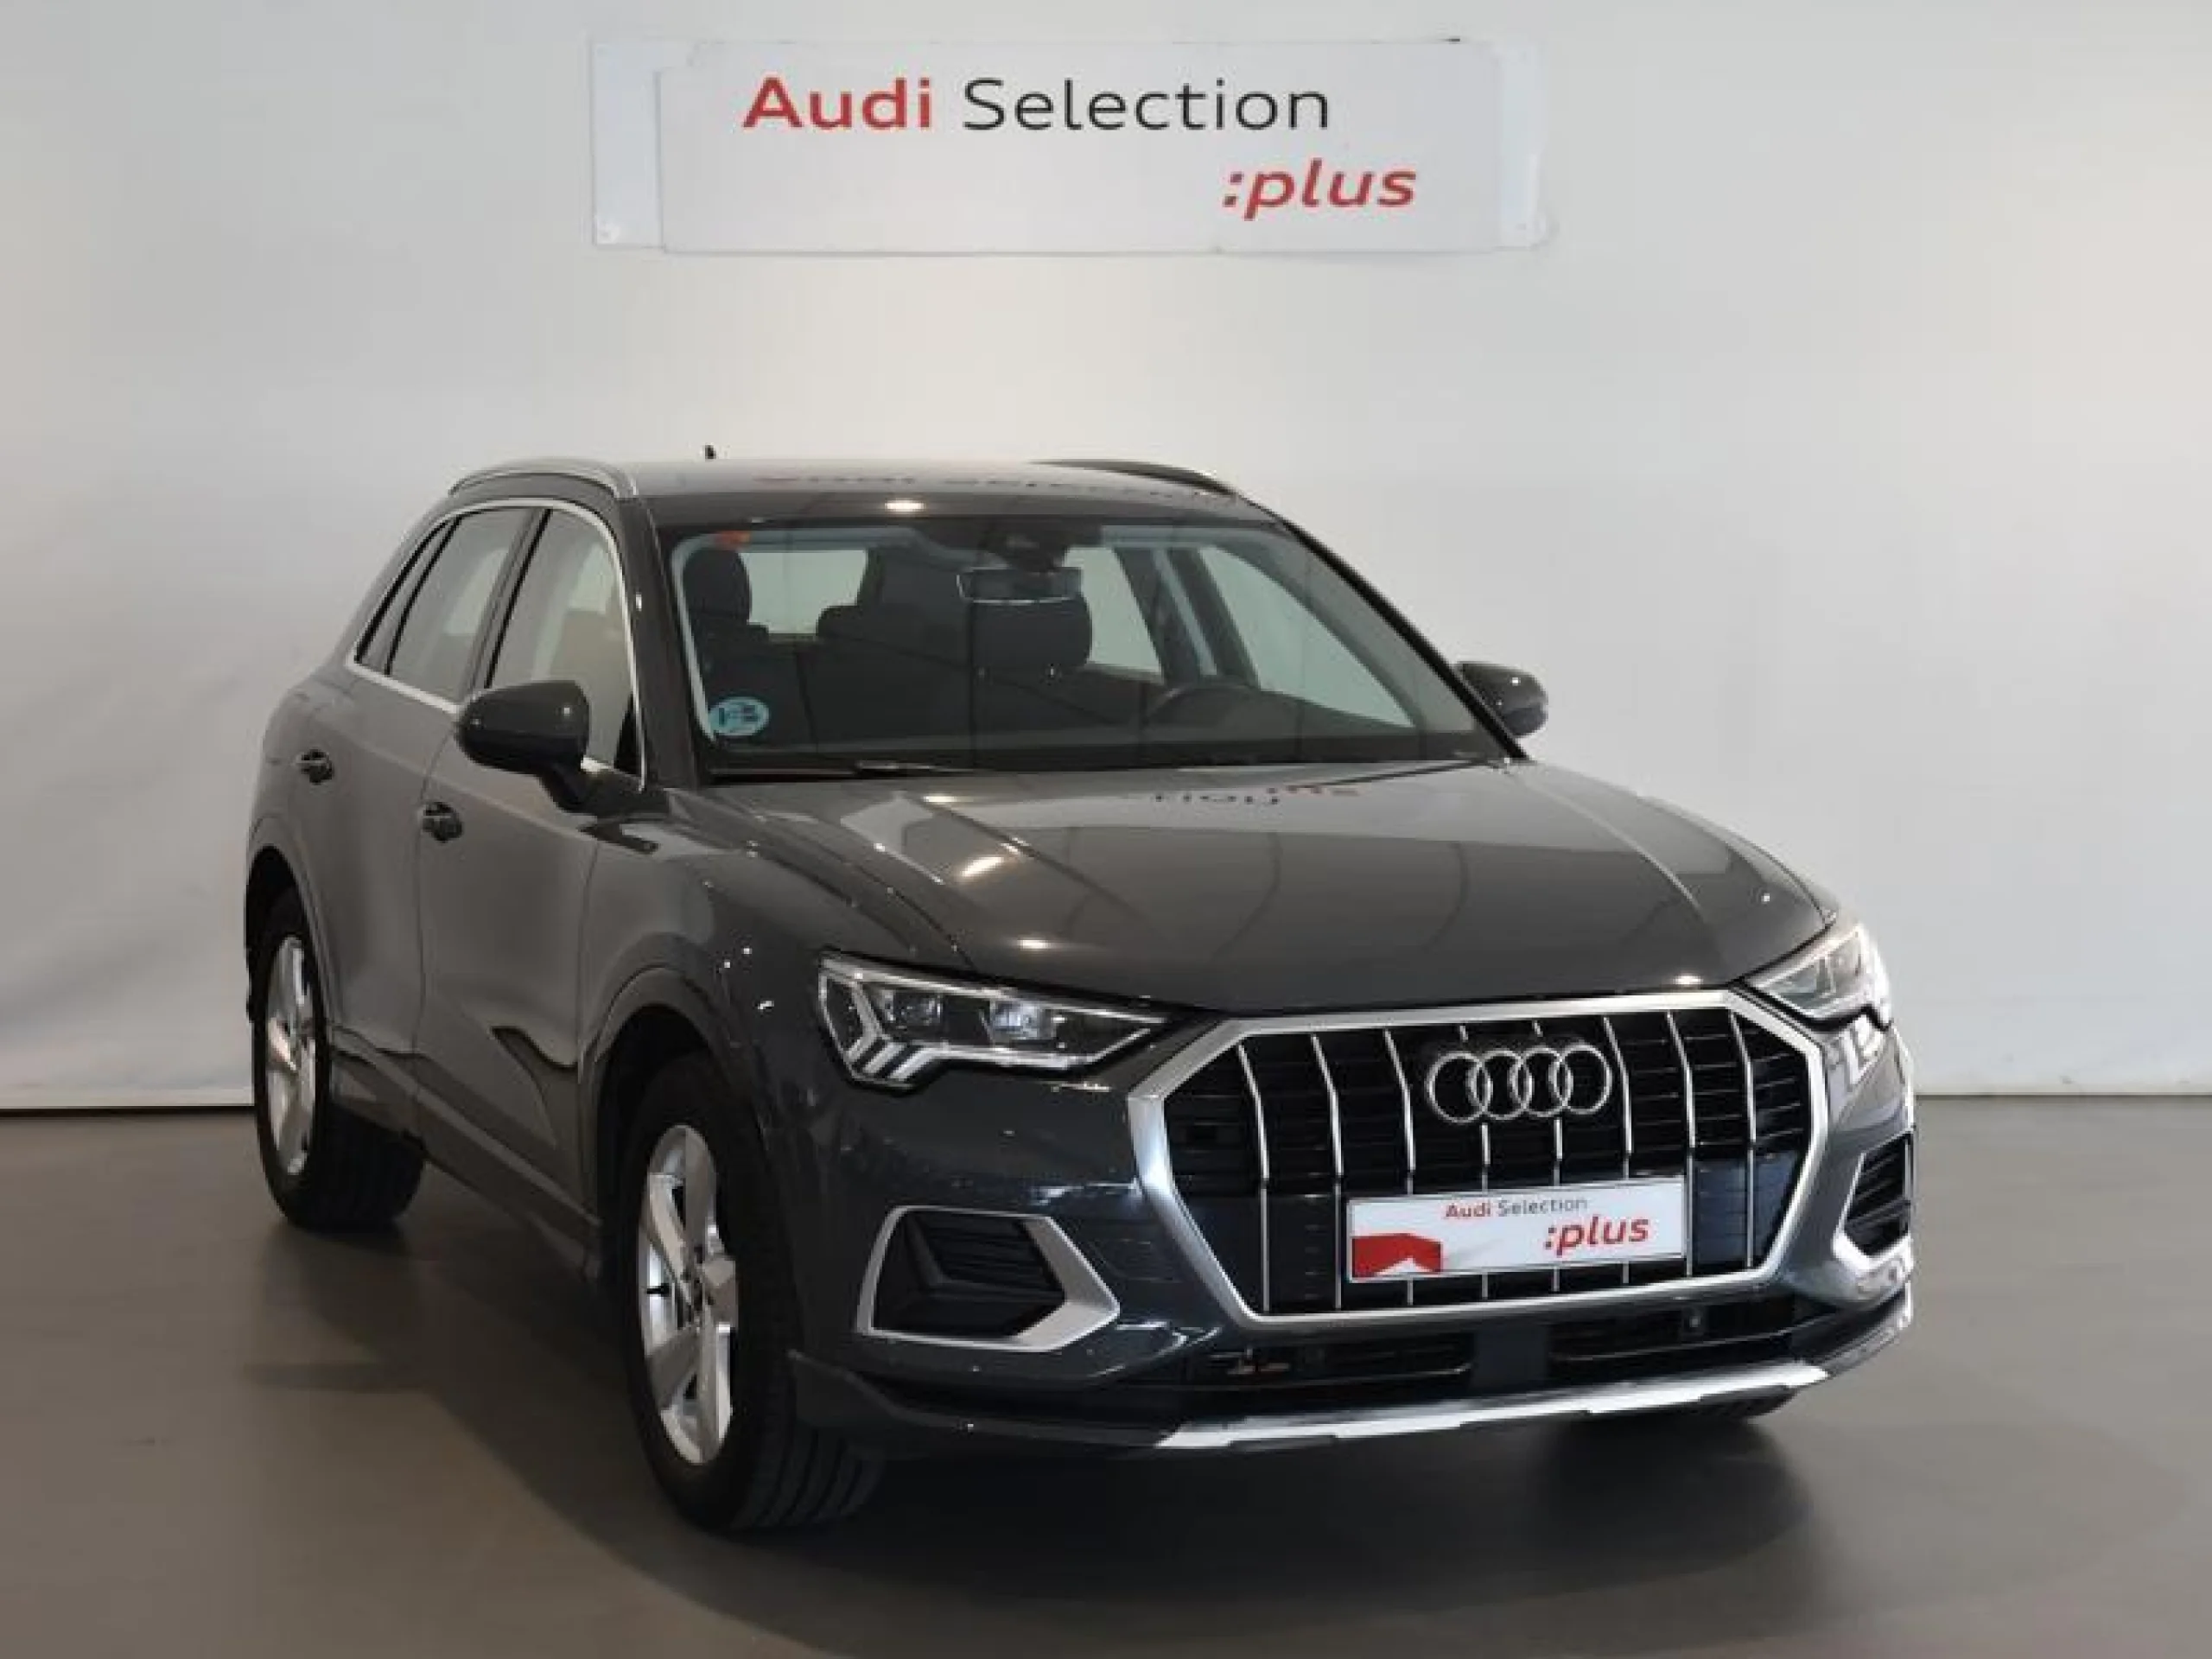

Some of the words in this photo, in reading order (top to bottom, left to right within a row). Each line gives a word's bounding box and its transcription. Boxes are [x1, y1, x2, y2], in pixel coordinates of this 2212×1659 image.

[741, 76, 931, 131] Audi
[963, 78, 1328, 130] Selection
[1223, 157, 1417, 221] :plus
[1444, 1202, 1491, 1219] Audi
[1497, 1197, 1588, 1217] Selection
[1543, 1214, 1650, 1256] :plus
